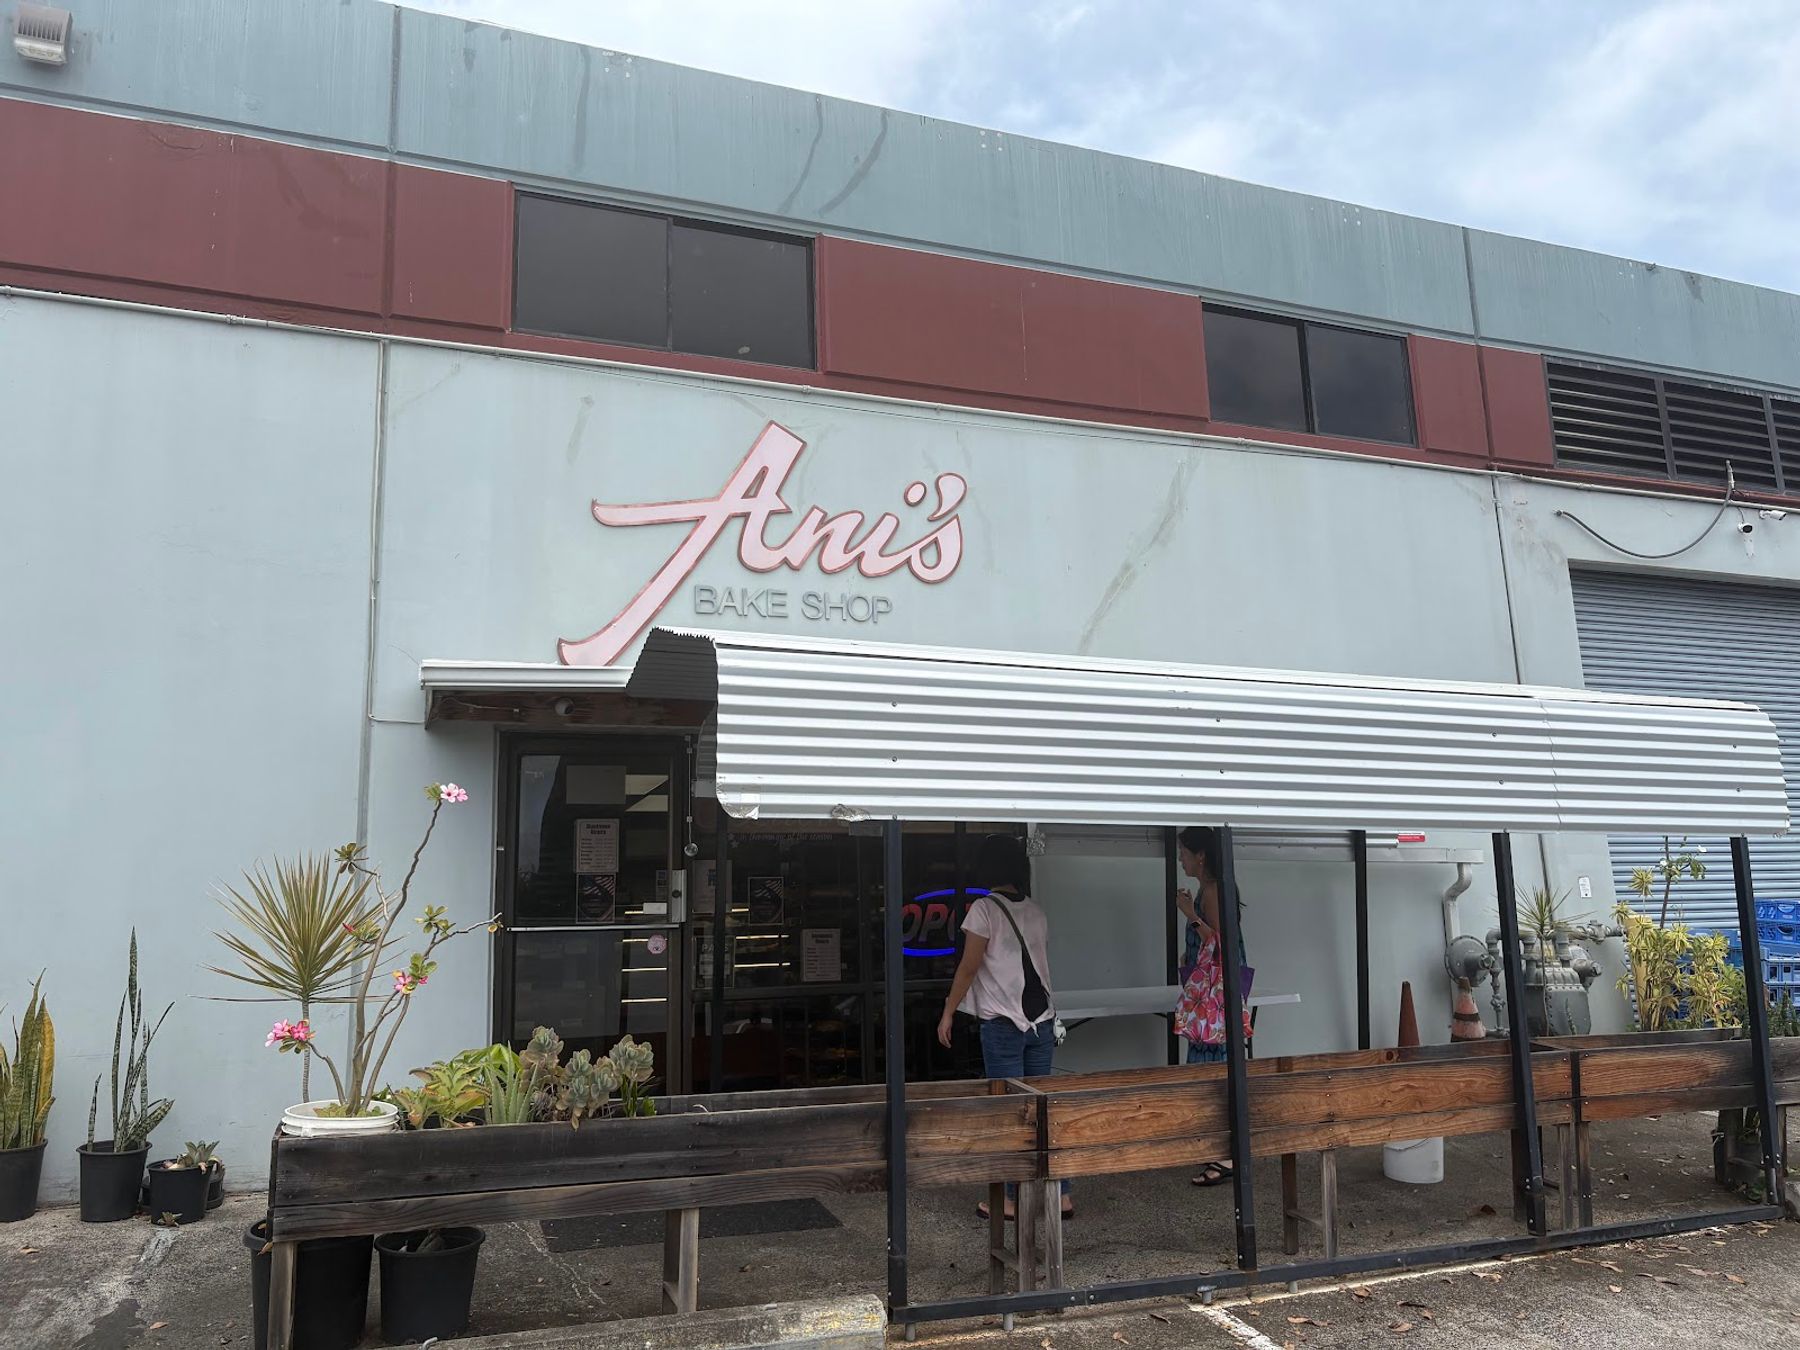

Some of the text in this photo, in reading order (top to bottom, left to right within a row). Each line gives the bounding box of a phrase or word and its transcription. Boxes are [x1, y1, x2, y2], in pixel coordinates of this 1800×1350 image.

[557, 420, 967, 666] Ani's
[694, 584, 893, 623] BAKE SHOP
